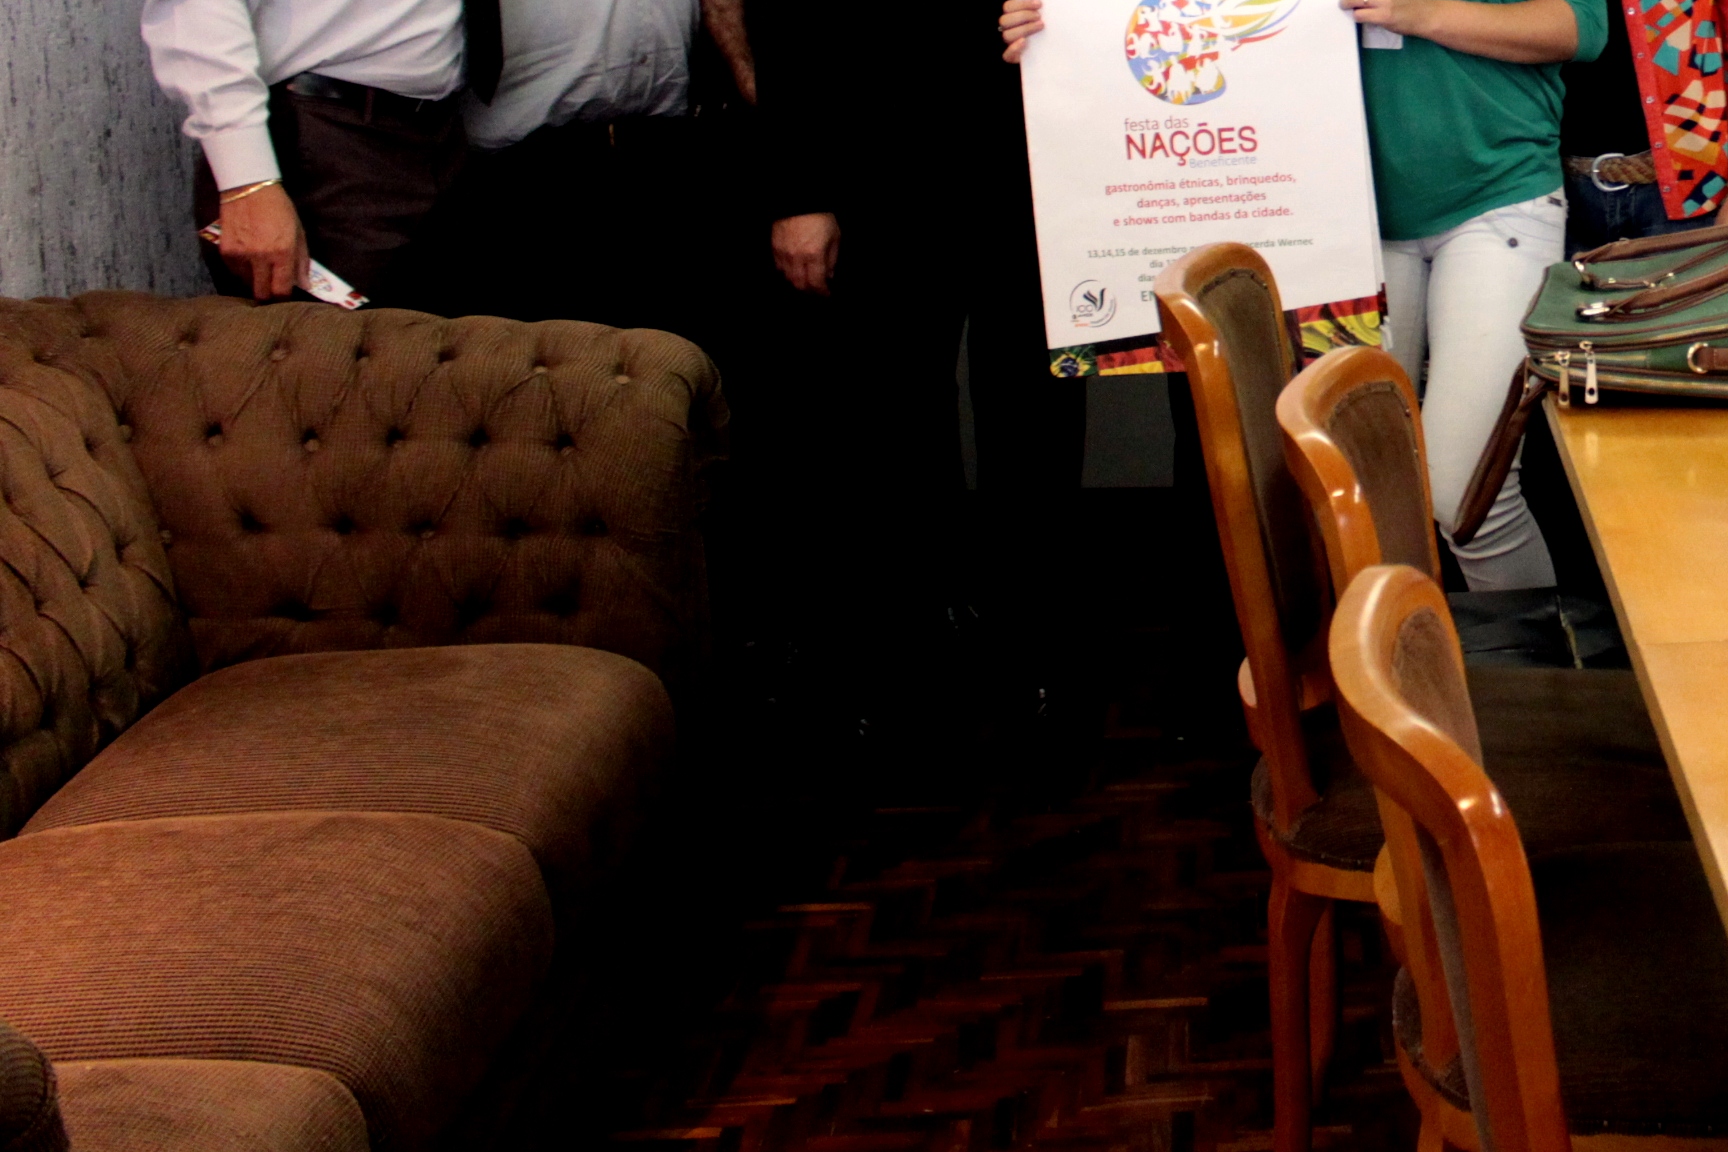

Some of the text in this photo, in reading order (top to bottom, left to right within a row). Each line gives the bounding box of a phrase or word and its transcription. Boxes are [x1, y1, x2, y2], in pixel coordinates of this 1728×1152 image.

[1124, 115, 1189, 132] festa das
[1125, 122, 1258, 166] NAÇÕES
[1189, 155, 1257, 168] Beneficente
[1178, 178, 1223, 190] étnicas,
[1226, 172, 1296, 186] brinquedos,
[1136, 191, 1267, 210] danças, apresentações
[1113, 206, 1294, 226] e shows com bandas da cidade.
[1128, 247, 1139, 256] de
[1141, 245, 1187, 256] dezembro
[1149, 259, 1163, 268] dia
